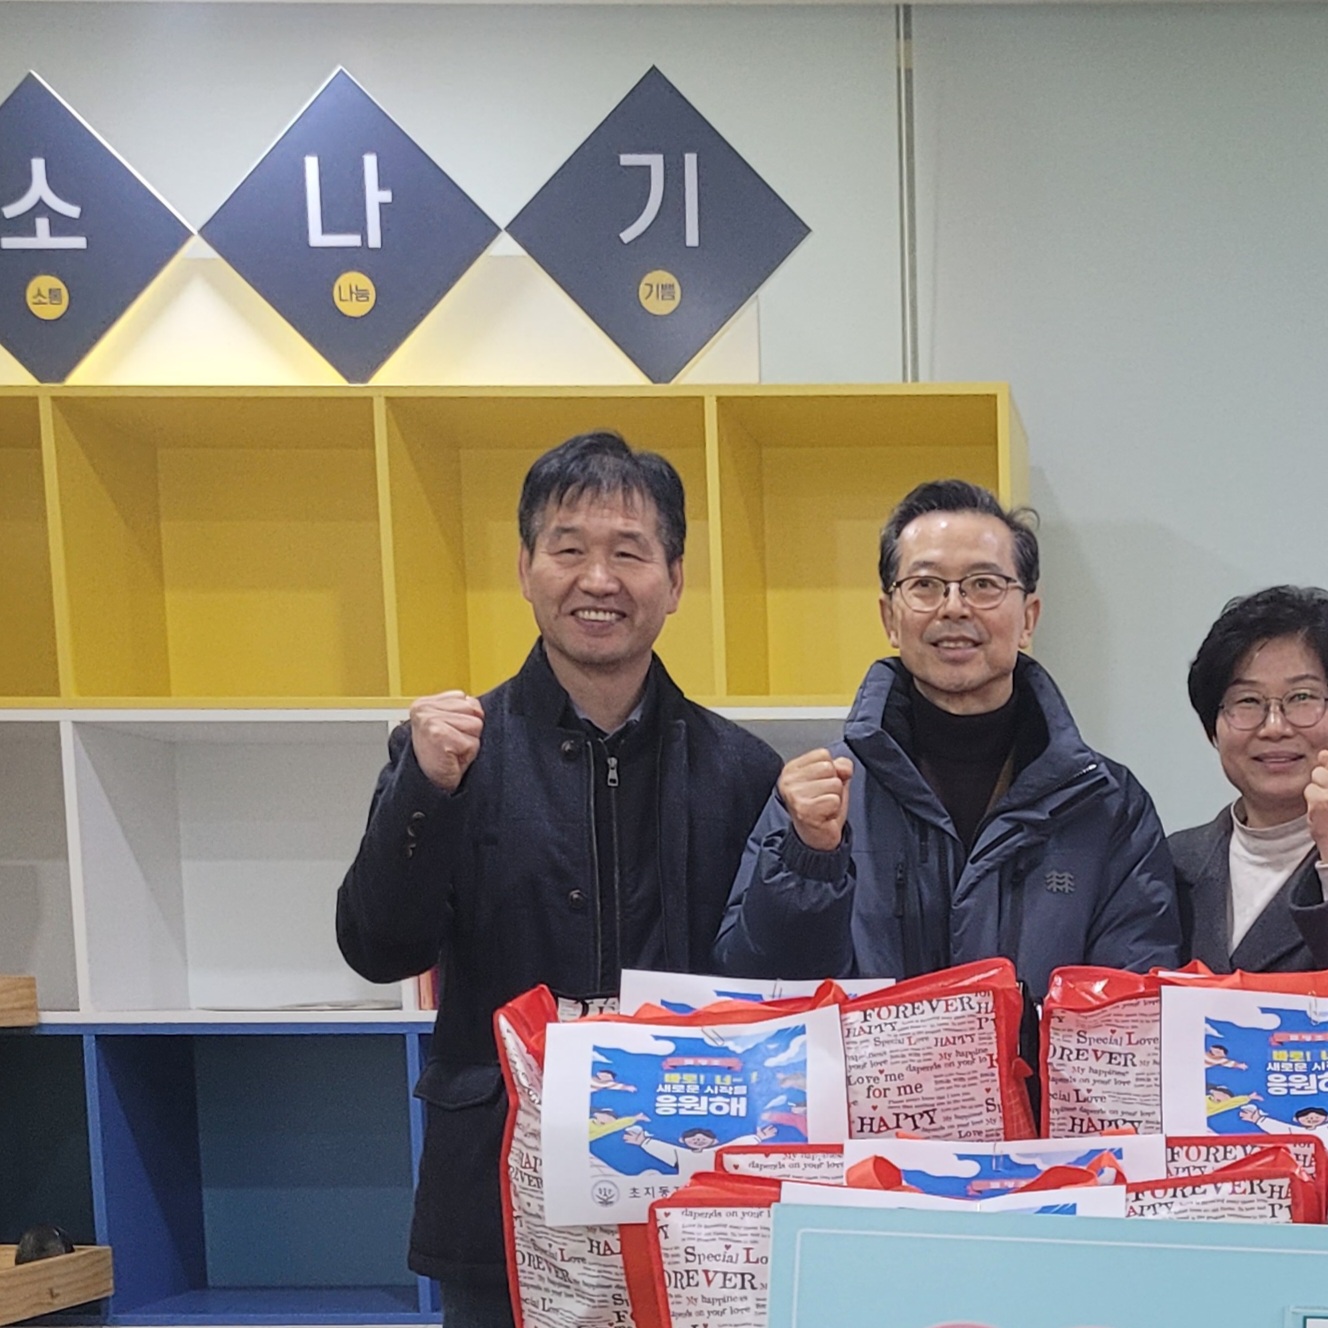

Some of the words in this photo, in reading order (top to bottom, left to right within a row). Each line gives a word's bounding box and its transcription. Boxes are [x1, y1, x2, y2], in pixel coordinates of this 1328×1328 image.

[1, 157, 87, 249] 소
[304, 152, 393, 248] 나
[618, 152, 700, 247] 기
[643, 283, 676, 301] 기쁨
[862, 996, 974, 1022] FOREVER
[1077, 1030, 1122, 1046] Special
[1126, 1032, 1159, 1045] Love
[1267, 1062, 1308, 1072] 새로운
[847, 1075, 880, 1086] Love
[884, 1073, 904, 1082] me
[656, 1084, 701, 1094] 새로운
[866, 1085, 890, 1099] for
[897, 1082, 923, 1096] me
[1073, 1089, 1106, 1103] Love
[655, 1095, 748, 1117] 응원해
[857, 1108, 937, 1134] HAPPY
[958, 1129, 983, 1138] Love
[741, 1209, 763, 1219] your
[684, 1246, 739, 1265] Special
[686, 1296, 698, 1306] My
[707, 1308, 727, 1318] your
[730, 1306, 750, 1315] love
